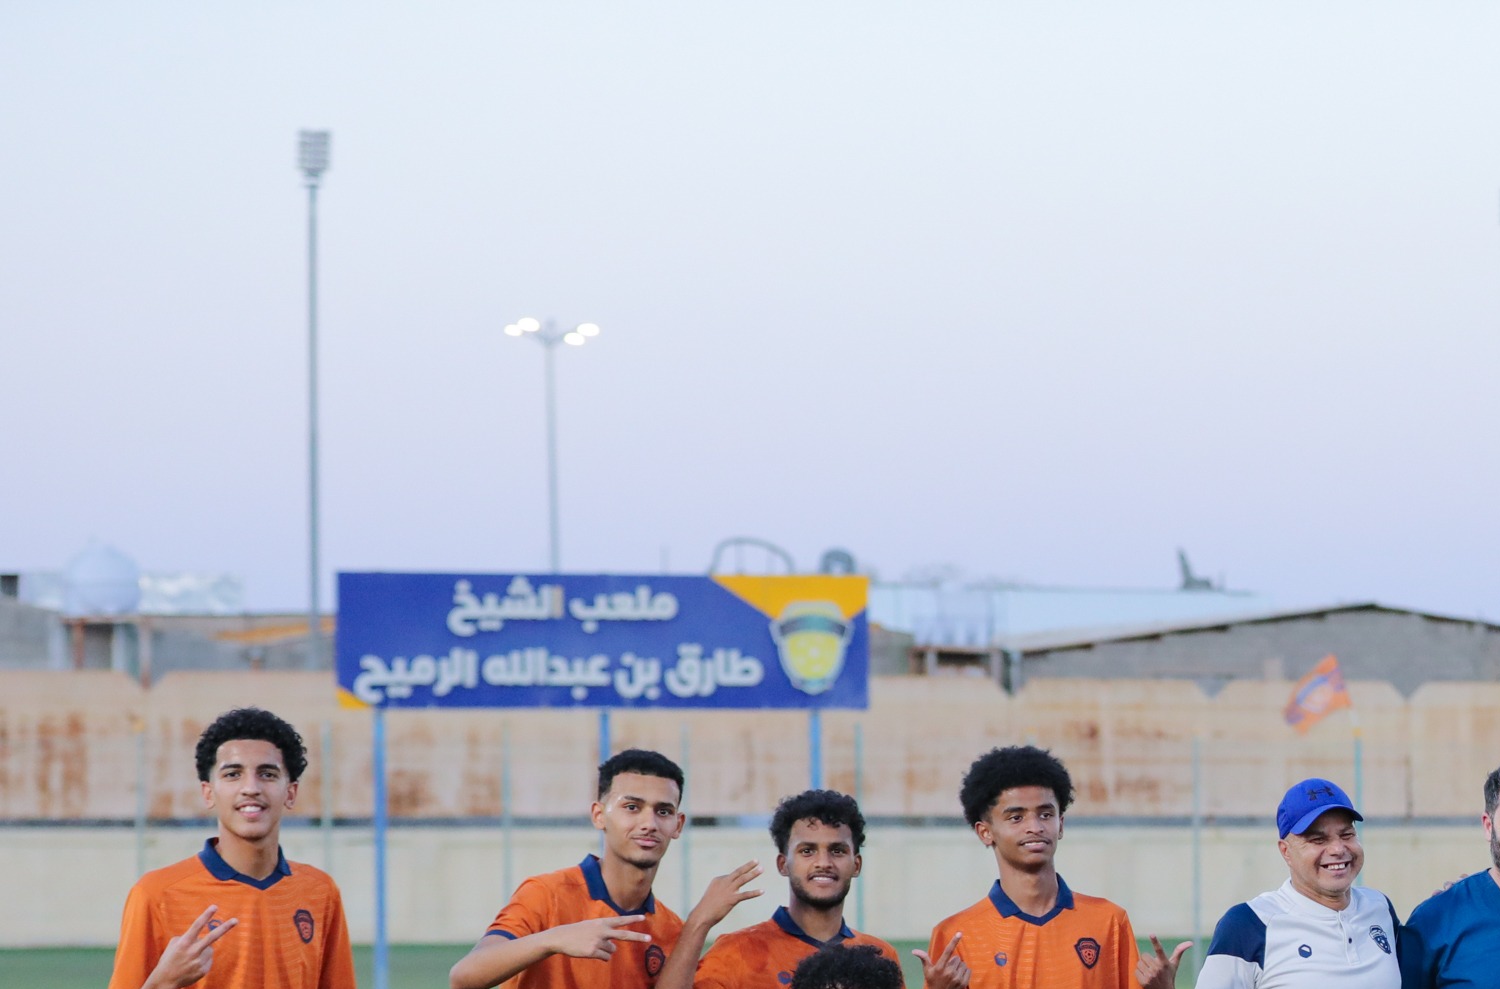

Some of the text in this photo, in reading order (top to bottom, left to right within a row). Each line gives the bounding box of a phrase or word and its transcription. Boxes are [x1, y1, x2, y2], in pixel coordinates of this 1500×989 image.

[447, 576, 679, 636] ملعب الشيخ
[353, 643, 764, 704] طارق بن عبدالله الرميح
